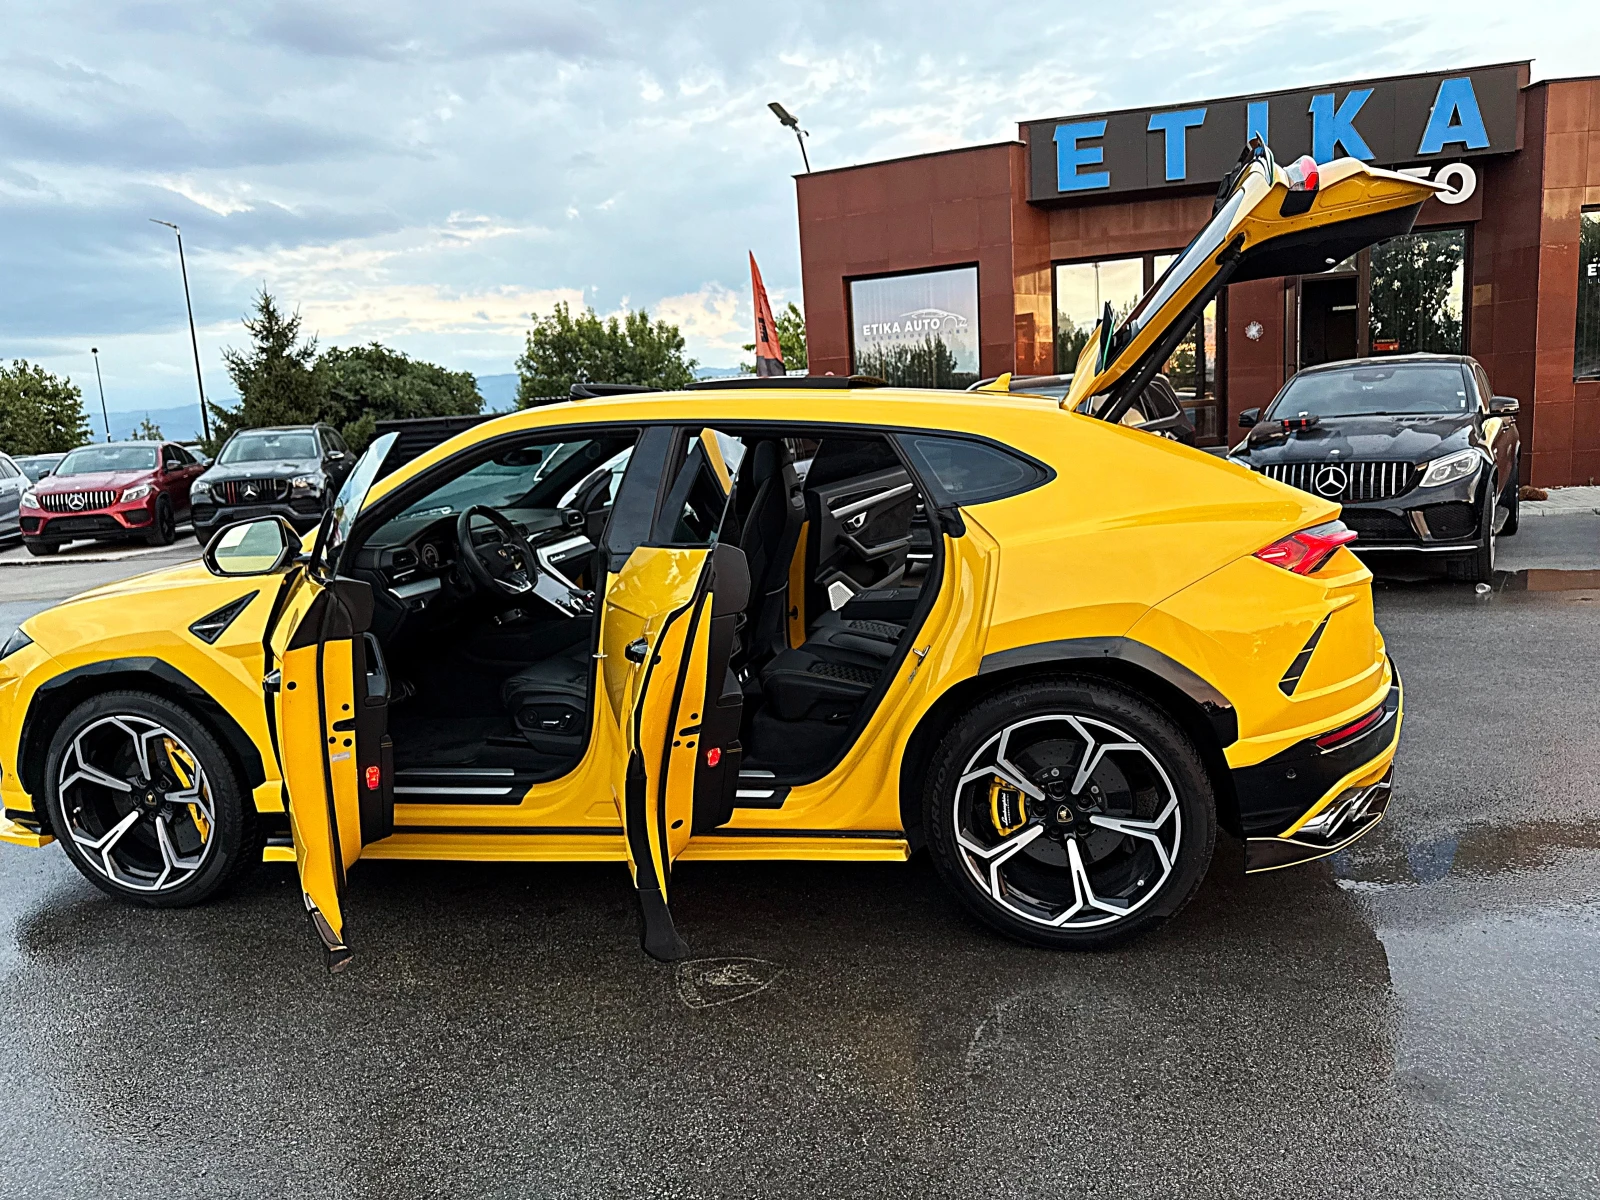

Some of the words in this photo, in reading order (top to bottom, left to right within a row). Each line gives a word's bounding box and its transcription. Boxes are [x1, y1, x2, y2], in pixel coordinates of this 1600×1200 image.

[1052, 76, 1490, 192] ETIKA
[863, 322, 901, 336] ETIKA
[904, 318, 941, 333] AUTO
